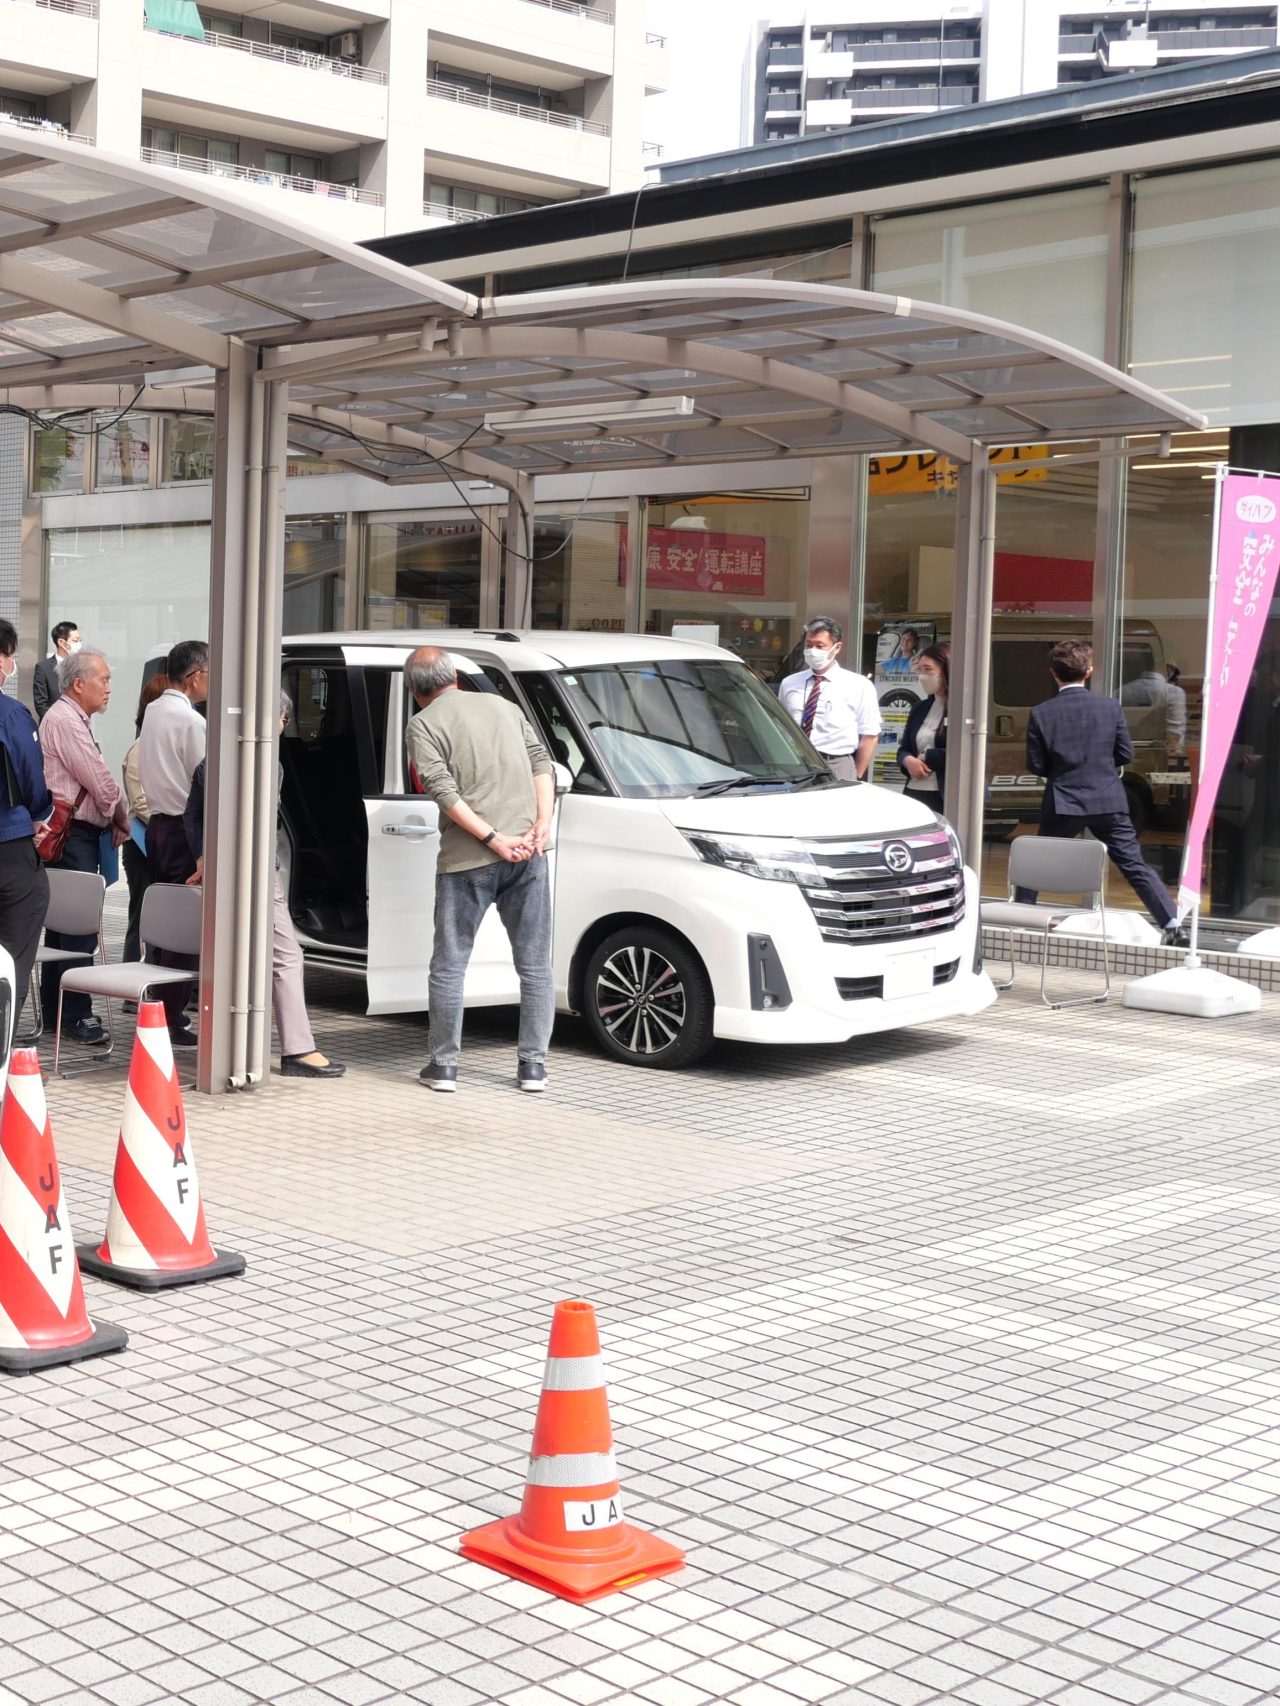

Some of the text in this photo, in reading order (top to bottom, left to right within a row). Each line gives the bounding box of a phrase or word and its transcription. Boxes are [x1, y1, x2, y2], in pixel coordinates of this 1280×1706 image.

[1243, 533, 1275, 617] みんなの
[167, 1103, 190, 1206] JAF
[39, 1161, 64, 1276] JAF
